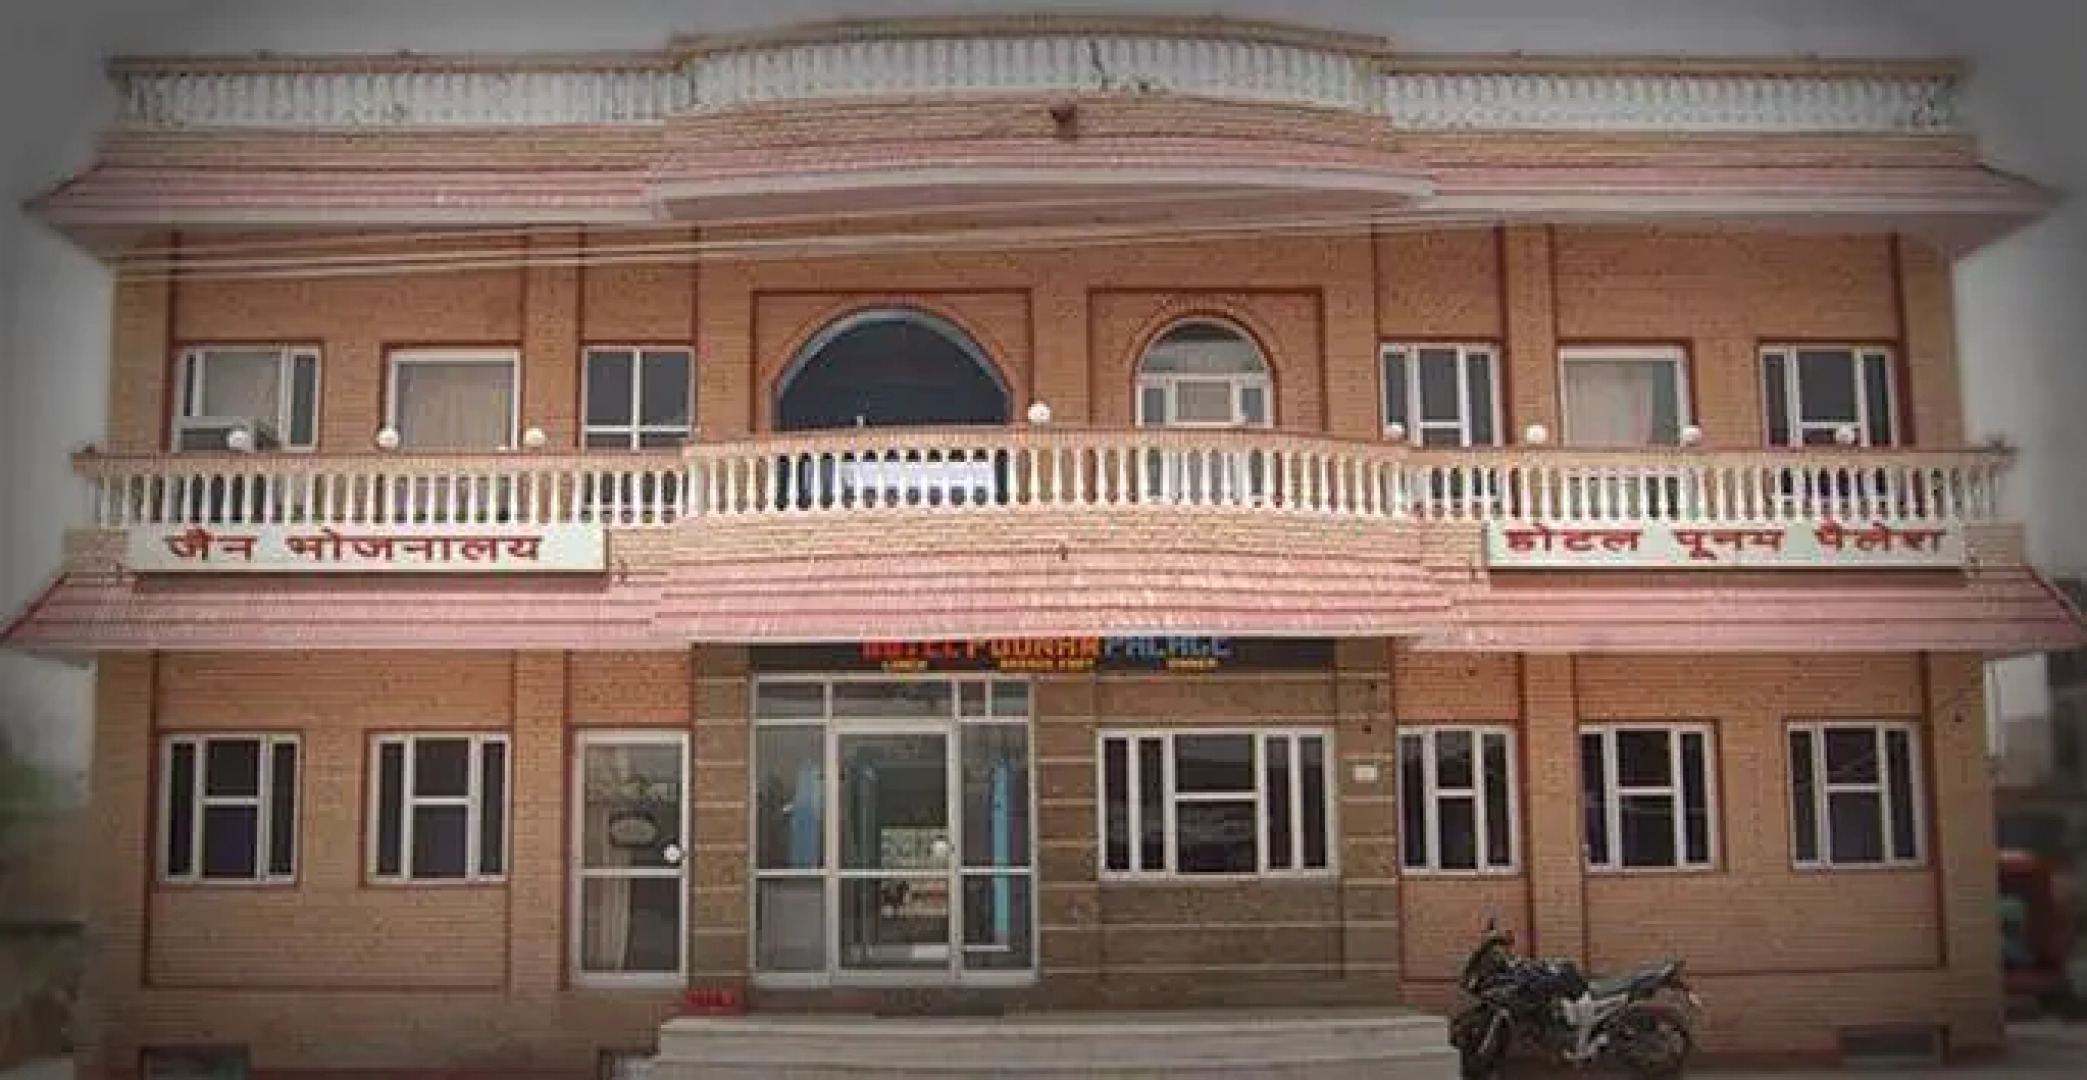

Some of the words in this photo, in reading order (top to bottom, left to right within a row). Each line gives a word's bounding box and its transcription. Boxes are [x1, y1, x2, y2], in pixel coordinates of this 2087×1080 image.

[166, 527, 256, 559] जैन
[286, 526, 542, 560] भोजनालय
[1505, 523, 1642, 552] होटल
[1671, 527, 1785, 560] पूनम
